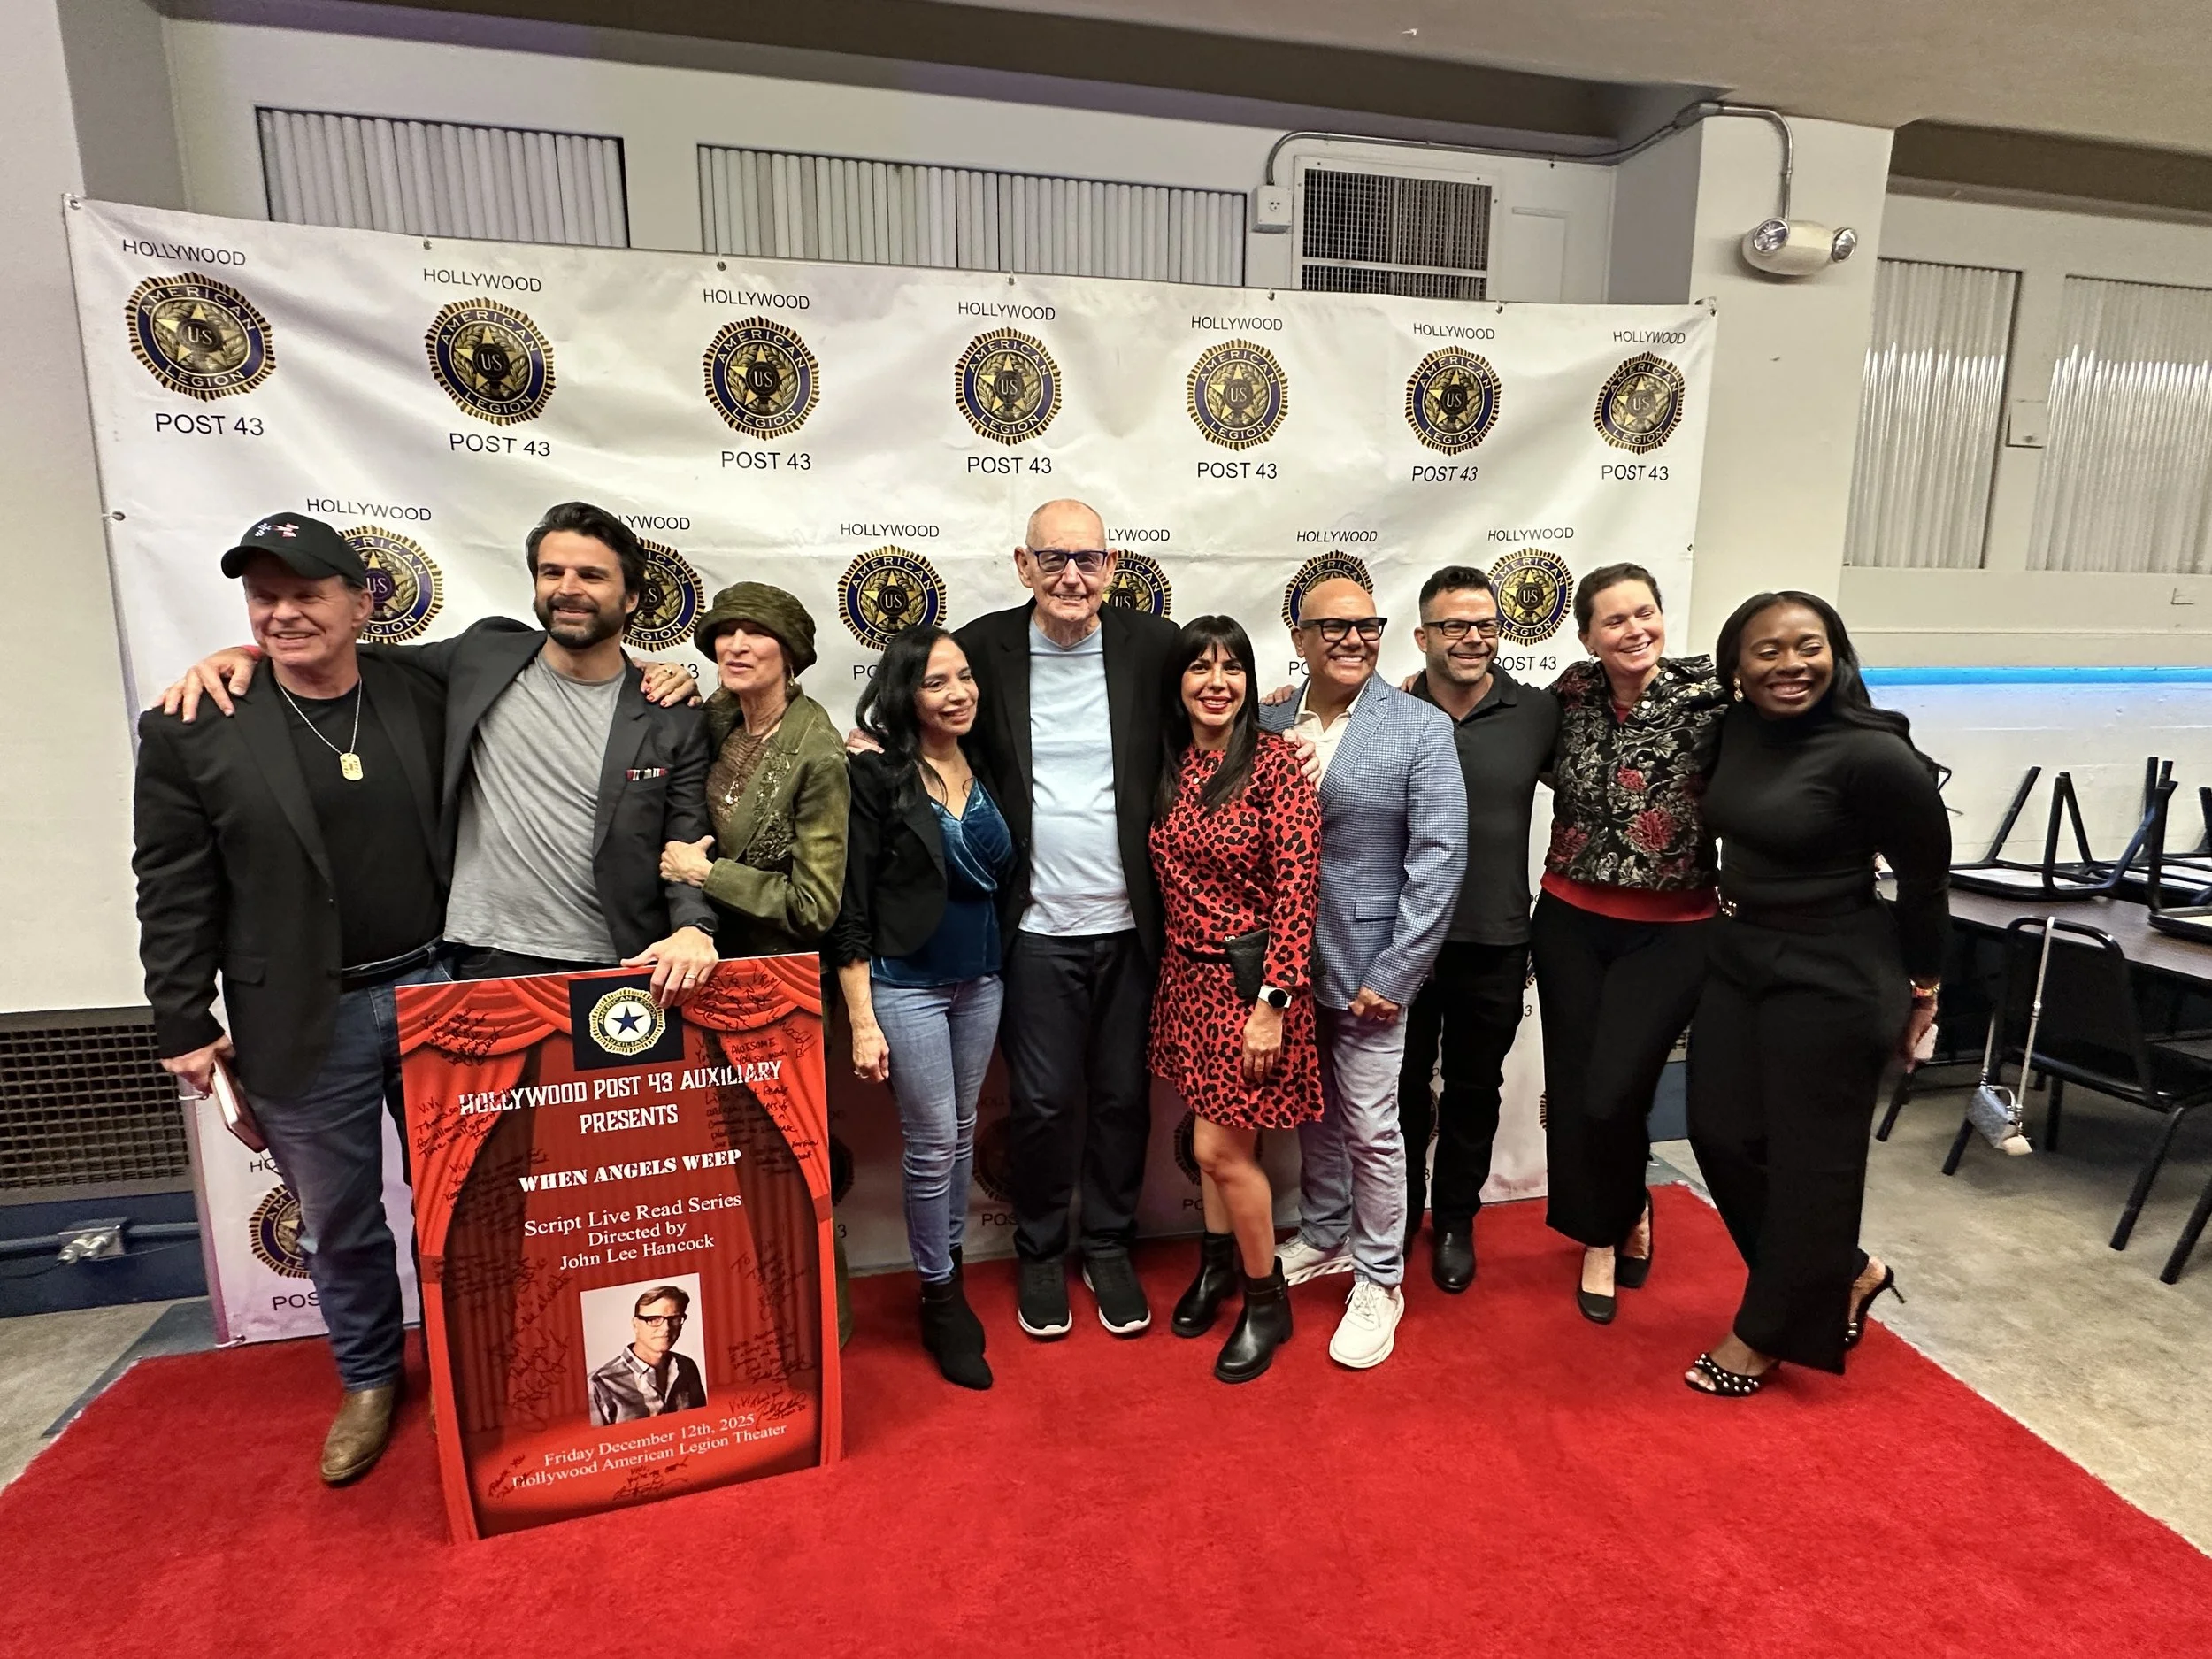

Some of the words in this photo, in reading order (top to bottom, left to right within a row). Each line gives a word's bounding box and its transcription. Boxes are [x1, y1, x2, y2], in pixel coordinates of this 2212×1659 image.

[123, 240, 246, 265] HOLLYWOOD
[424, 268, 541, 292] HOLLYWOOD
[142, 286, 256, 330] AMERICAN
[703, 289, 810, 309] HOLLYWOOD
[958, 302, 1056, 320] HOLLYWOOD
[442, 310, 537, 351] AMERICAN
[1192, 316, 1283, 330] HOLLYWOOD
[1414, 323, 1495, 340] HOLLYWOOD
[1613, 331, 1686, 344] HOLLYWOOD
[718, 330, 805, 368] AMERICAN
[969, 341, 1049, 375] AMERICAN
[165, 365, 245, 387] LEGION
[1201, 350, 1277, 384] AMERICAN
[1420, 357, 1491, 389] AMERICAN
[1611, 364, 1678, 393] AMERICAN
[465, 392, 533, 413] LEGION
[156, 413, 225, 434] POST
[234, 418, 264, 436] 43
[733, 408, 795, 427] LEGION
[979, 414, 1040, 434] LEGION
[1210, 421, 1267, 439] LEGION
[1425, 426, 1478, 444] LEGION
[1613, 428, 1663, 443] LEGION
[450, 433, 517, 453] POST
[523, 441, 550, 457] 43
[722, 451, 780, 469] POST
[787, 454, 810, 470] 43
[968, 457, 1023, 473] POST
[1029, 457, 1051, 473] 43
[1197, 462, 1250, 478] POST
[1256, 463, 1277, 479] 43
[1412, 466, 1458, 481] POST
[1460, 466, 1478, 481] 43
[1601, 465, 1646, 480] POST
[1648, 466, 1669, 480] 43
[307, 499, 432, 521] HOLLYWOOD
[618, 515, 690, 530] YWOOD
[841, 524, 940, 537] HOLLYWOOD
[1108, 529, 1170, 541] LYWOOD
[1297, 531, 1378, 542] HOLLYWOOD
[1488, 527, 1574, 541] HOLLYWOOD
[348, 537, 427, 575] ERICAN
[648, 551, 688, 584] ICAN
[852, 557, 934, 590] AMERICAN
[1118, 561, 1161, 592] RICAN
[1494, 558, 1565, 587] AMERICAN
[630, 624, 683, 641] EGION
[1503, 621, 1552, 635] LEGION
[1540, 657, 1556, 670] 43
[599, 995, 632, 1024] AMERICAN
[634, 996, 656, 1019] LEGION
[604, 1033, 649, 1047] AUXILIARY
[731, 1037, 776, 1056] AWESOME
[458, 1081, 587, 1115] HOLLYWOOD
[593, 1076, 641, 1099] POST
[648, 1072, 672, 1092] 43
[680, 1060, 782, 1090] AUXILIARY
[580, 1104, 678, 1134] PRESENTS
[518, 1169, 588, 1193] WHEN
[594, 1157, 677, 1183] ANGELS
[681, 1149, 742, 1169] WEEP
[524, 1216, 581, 1236] Script
[588, 1210, 630, 1227] Live
[636, 1200, 683, 1219] Read
[688, 1194, 741, 1212] Series
[981, 1213, 1018, 1226] POS
[588, 1223, 660, 1247] Directed
[665, 1221, 687, 1237] by
[560, 1253, 601, 1270] John
[607, 1248, 637, 1263] Lee
[642, 1234, 714, 1256] Hancock
[273, 1291, 320, 1310] POS
[545, 1448, 595, 1466] Friday
[599, 1432, 676, 1455] December
[719, 1413, 755, 1431] 2025
[511, 1461, 597, 1489] Hollywood
[602, 1448, 674, 1471] American
[680, 1436, 729, 1455] Legion
[733, 1425, 787, 1443] Theater
